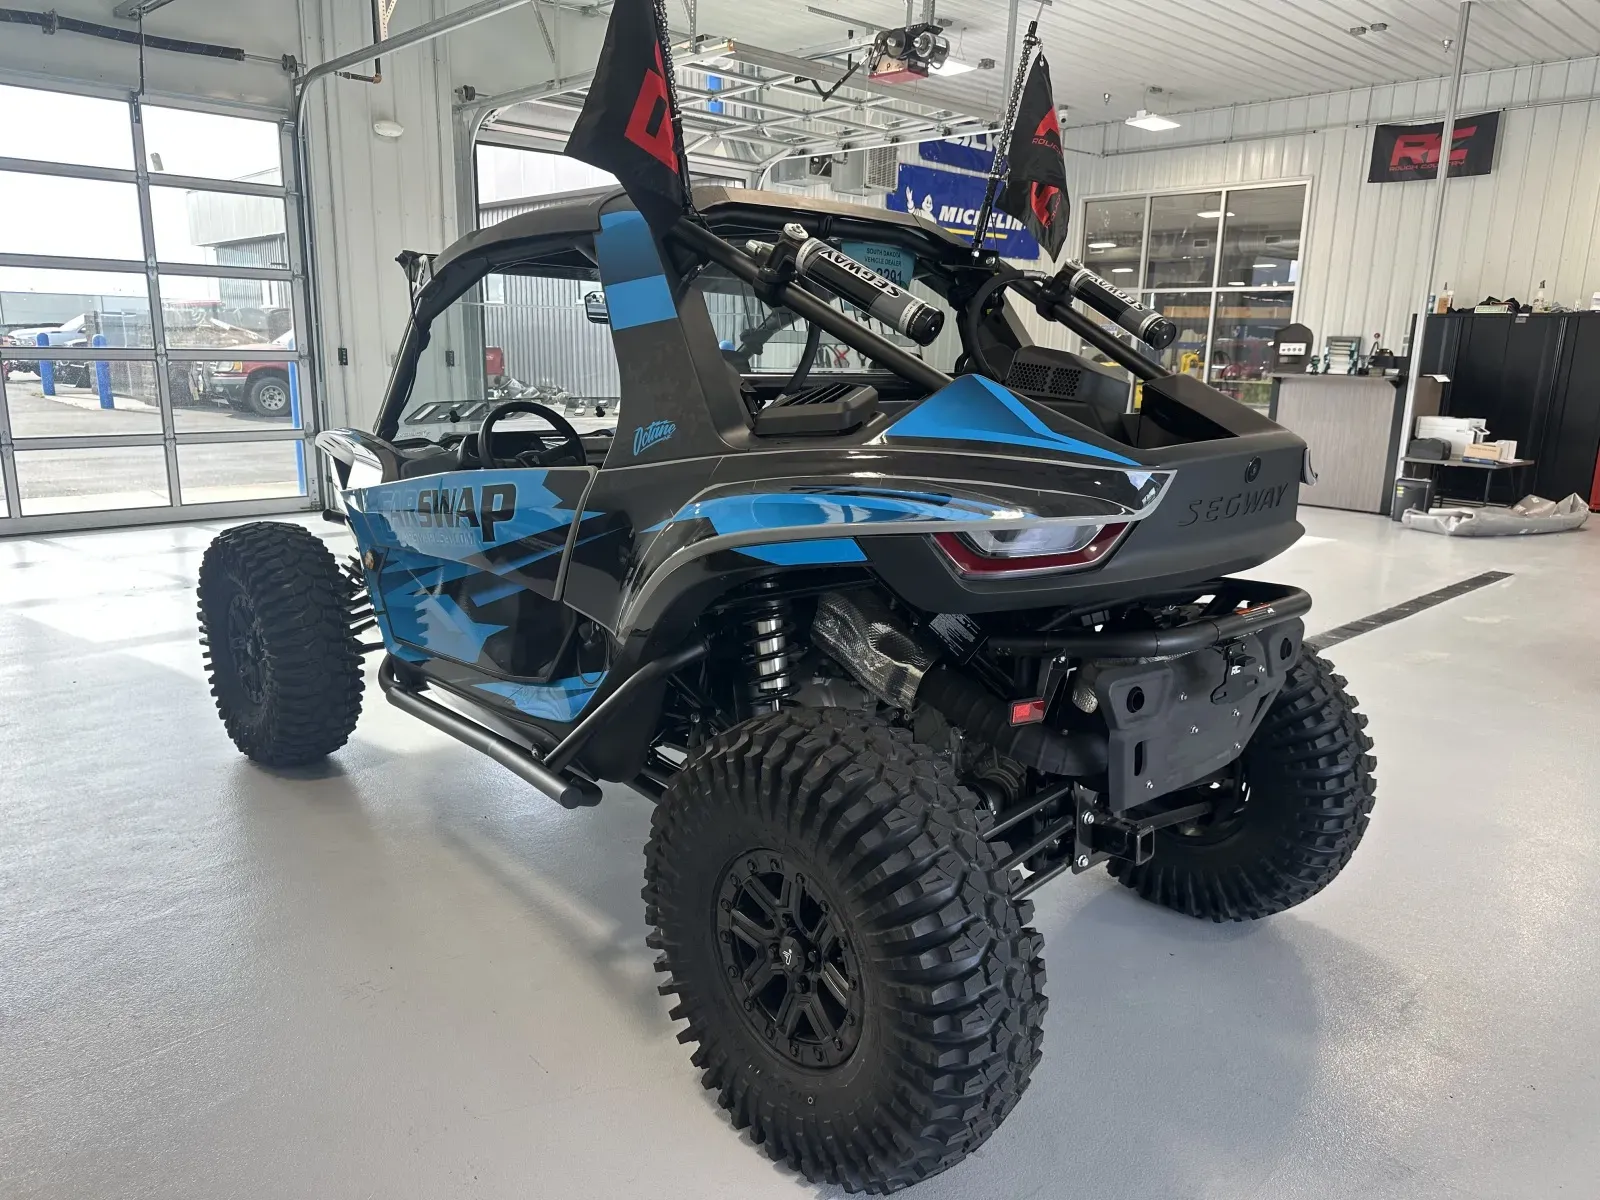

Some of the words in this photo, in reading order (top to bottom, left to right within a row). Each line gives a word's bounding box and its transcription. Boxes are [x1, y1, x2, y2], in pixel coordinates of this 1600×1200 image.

[1420, 159, 1465, 170] COUTRY
[864, 256, 884, 264] VEHICLE
[884, 259, 902, 267] DEALER
[866, 248, 882, 256] SOUTH
[883, 250, 901, 258] DAKOTA
[820, 249, 900, 297] SEGWAY
[1088, 276, 1144, 311] SEGWAY
[633, 420, 676, 456] Octane
[1178, 482, 1288, 527] SEGWAY
